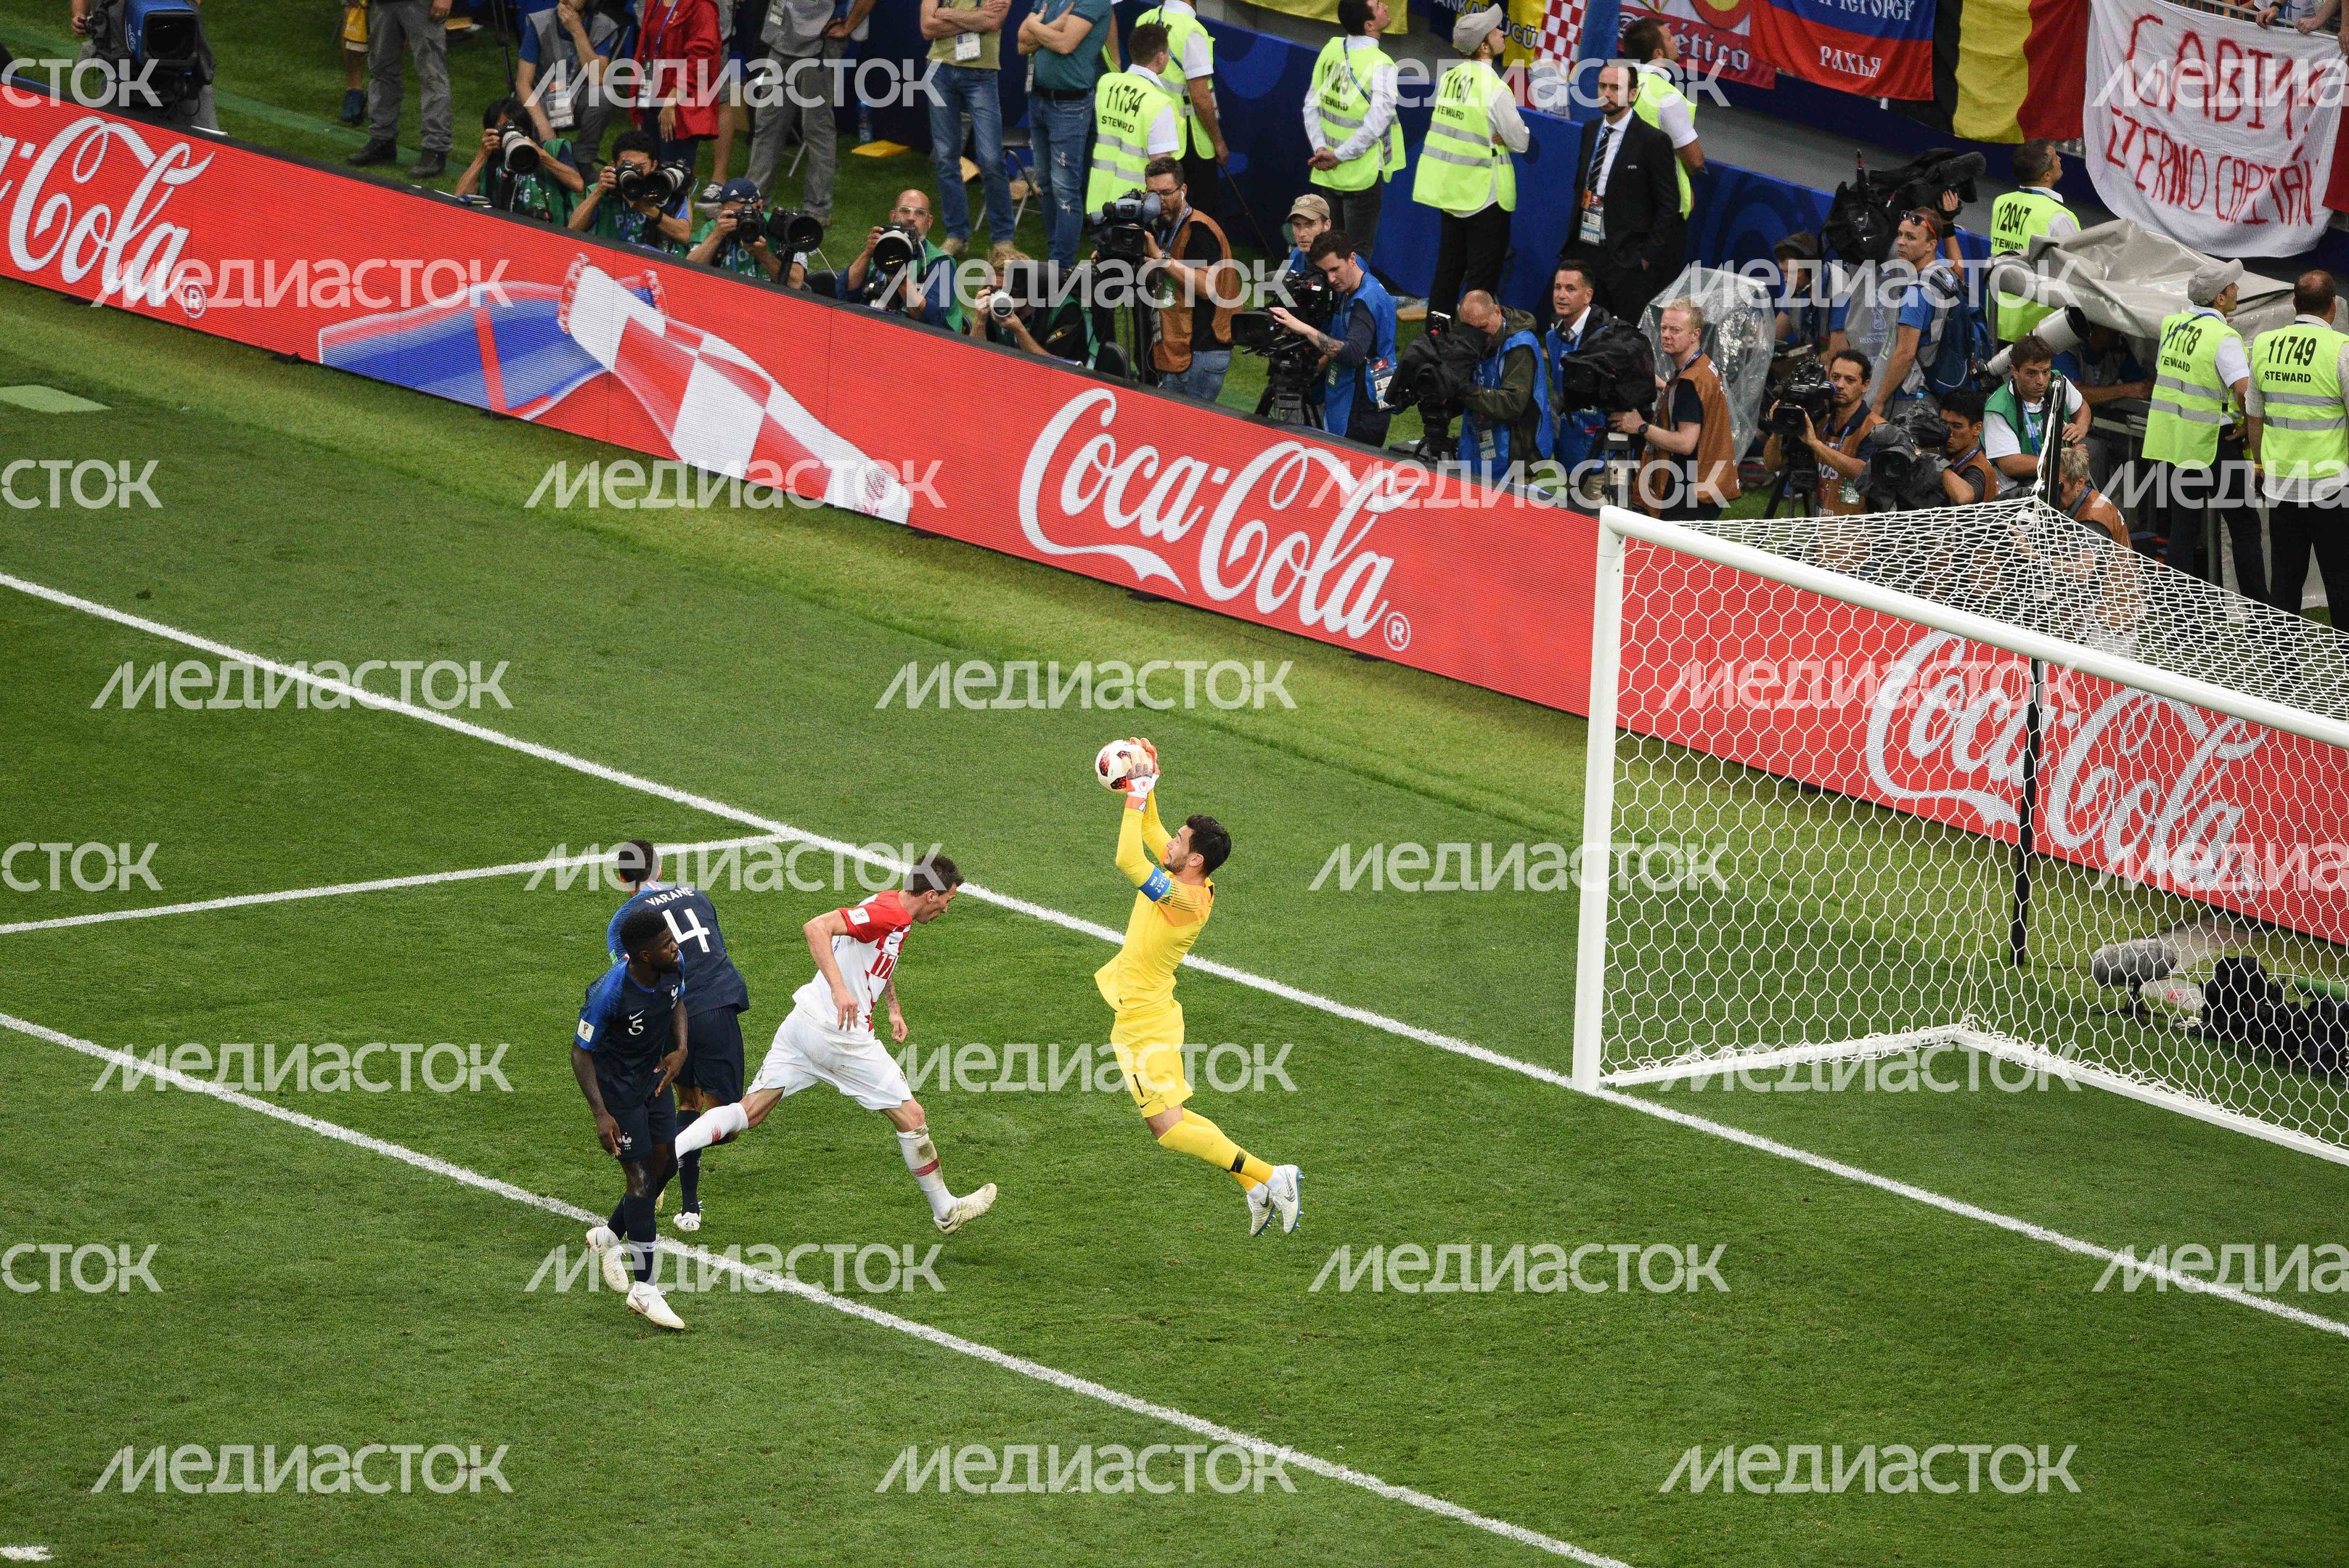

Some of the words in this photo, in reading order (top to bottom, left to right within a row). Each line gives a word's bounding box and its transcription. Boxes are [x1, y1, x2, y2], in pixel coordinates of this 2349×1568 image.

[1106, 81, 1147, 117] 11734
[1434, 104, 1465, 121] TEWARD
[1996, 200, 2032, 236] 12047
[1992, 237, 2024, 250] TEWARD
[2268, 335, 2316, 367] 11749
[2264, 370, 2311, 383] STEWARD
[1018, 388, 1421, 640] Coca-Cola
[1866, 629, 2273, 891] Coca-Cola
[645, 887, 695, 907] VARANE
[662, 907, 711, 953] 4
[875, 953, 896, 978] 17
[628, 1018, 644, 1036] 5
[1133, 1074, 1144, 1098] 1
